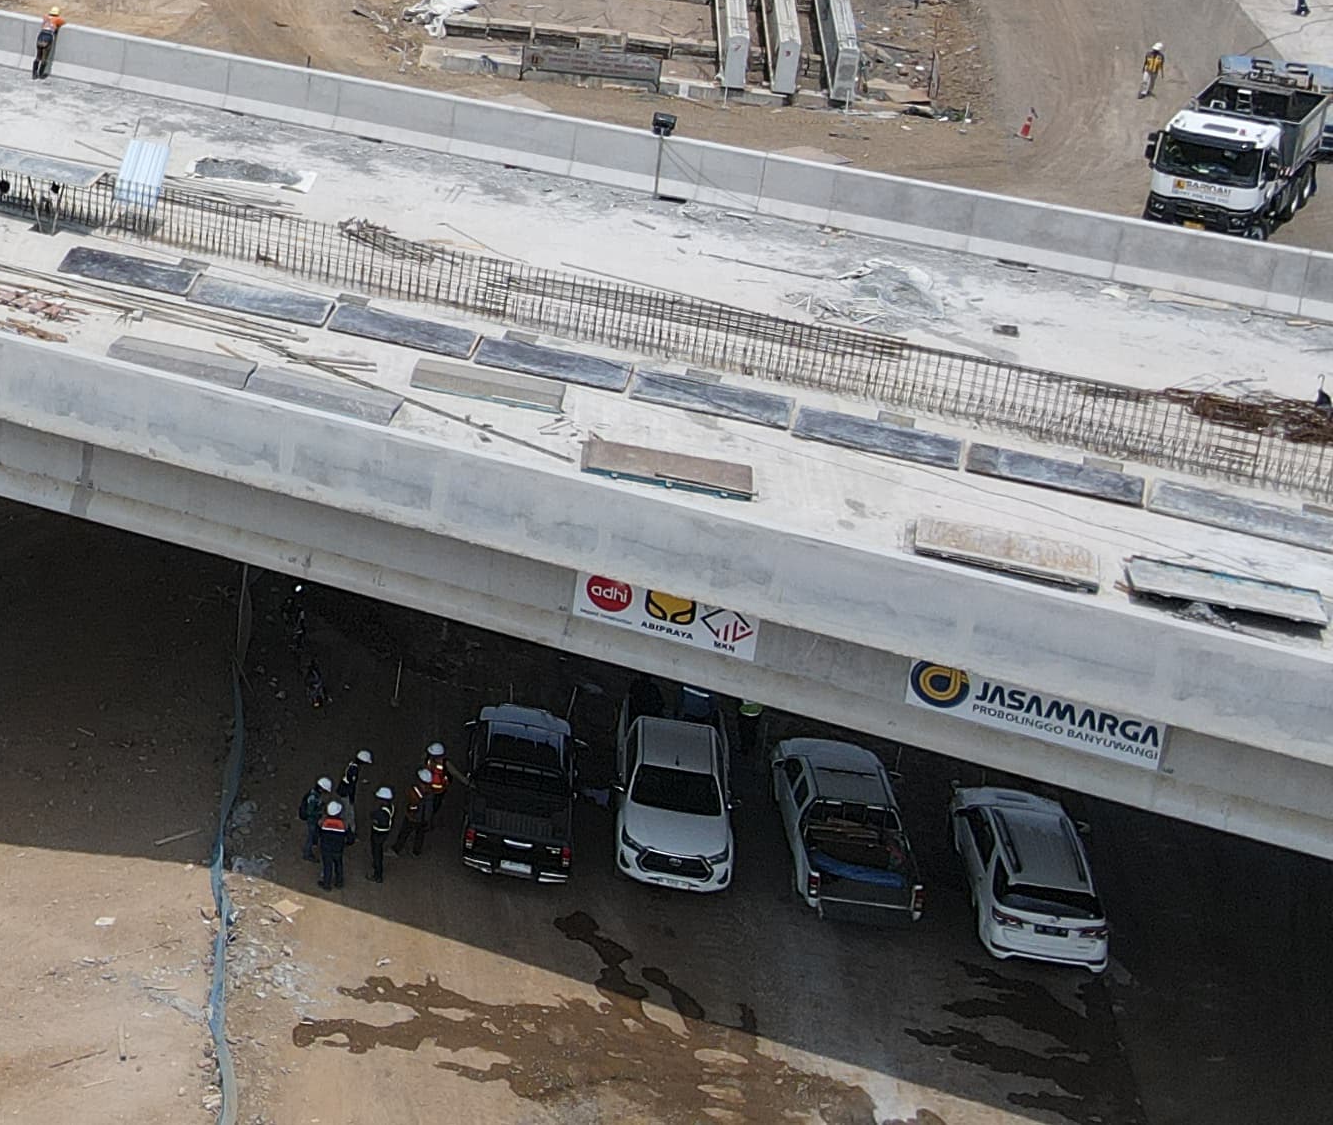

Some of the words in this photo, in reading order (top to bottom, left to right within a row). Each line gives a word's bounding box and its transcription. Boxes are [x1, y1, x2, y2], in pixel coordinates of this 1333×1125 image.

[591, 585, 628, 603] adhi
[641, 621, 693, 641] ABIPRAYA
[972, 704, 1064, 735] PROBOLINGGO
[1067, 729, 1158, 759] BANYUWANGI
[975, 681, 1160, 748] JASAMARGA
